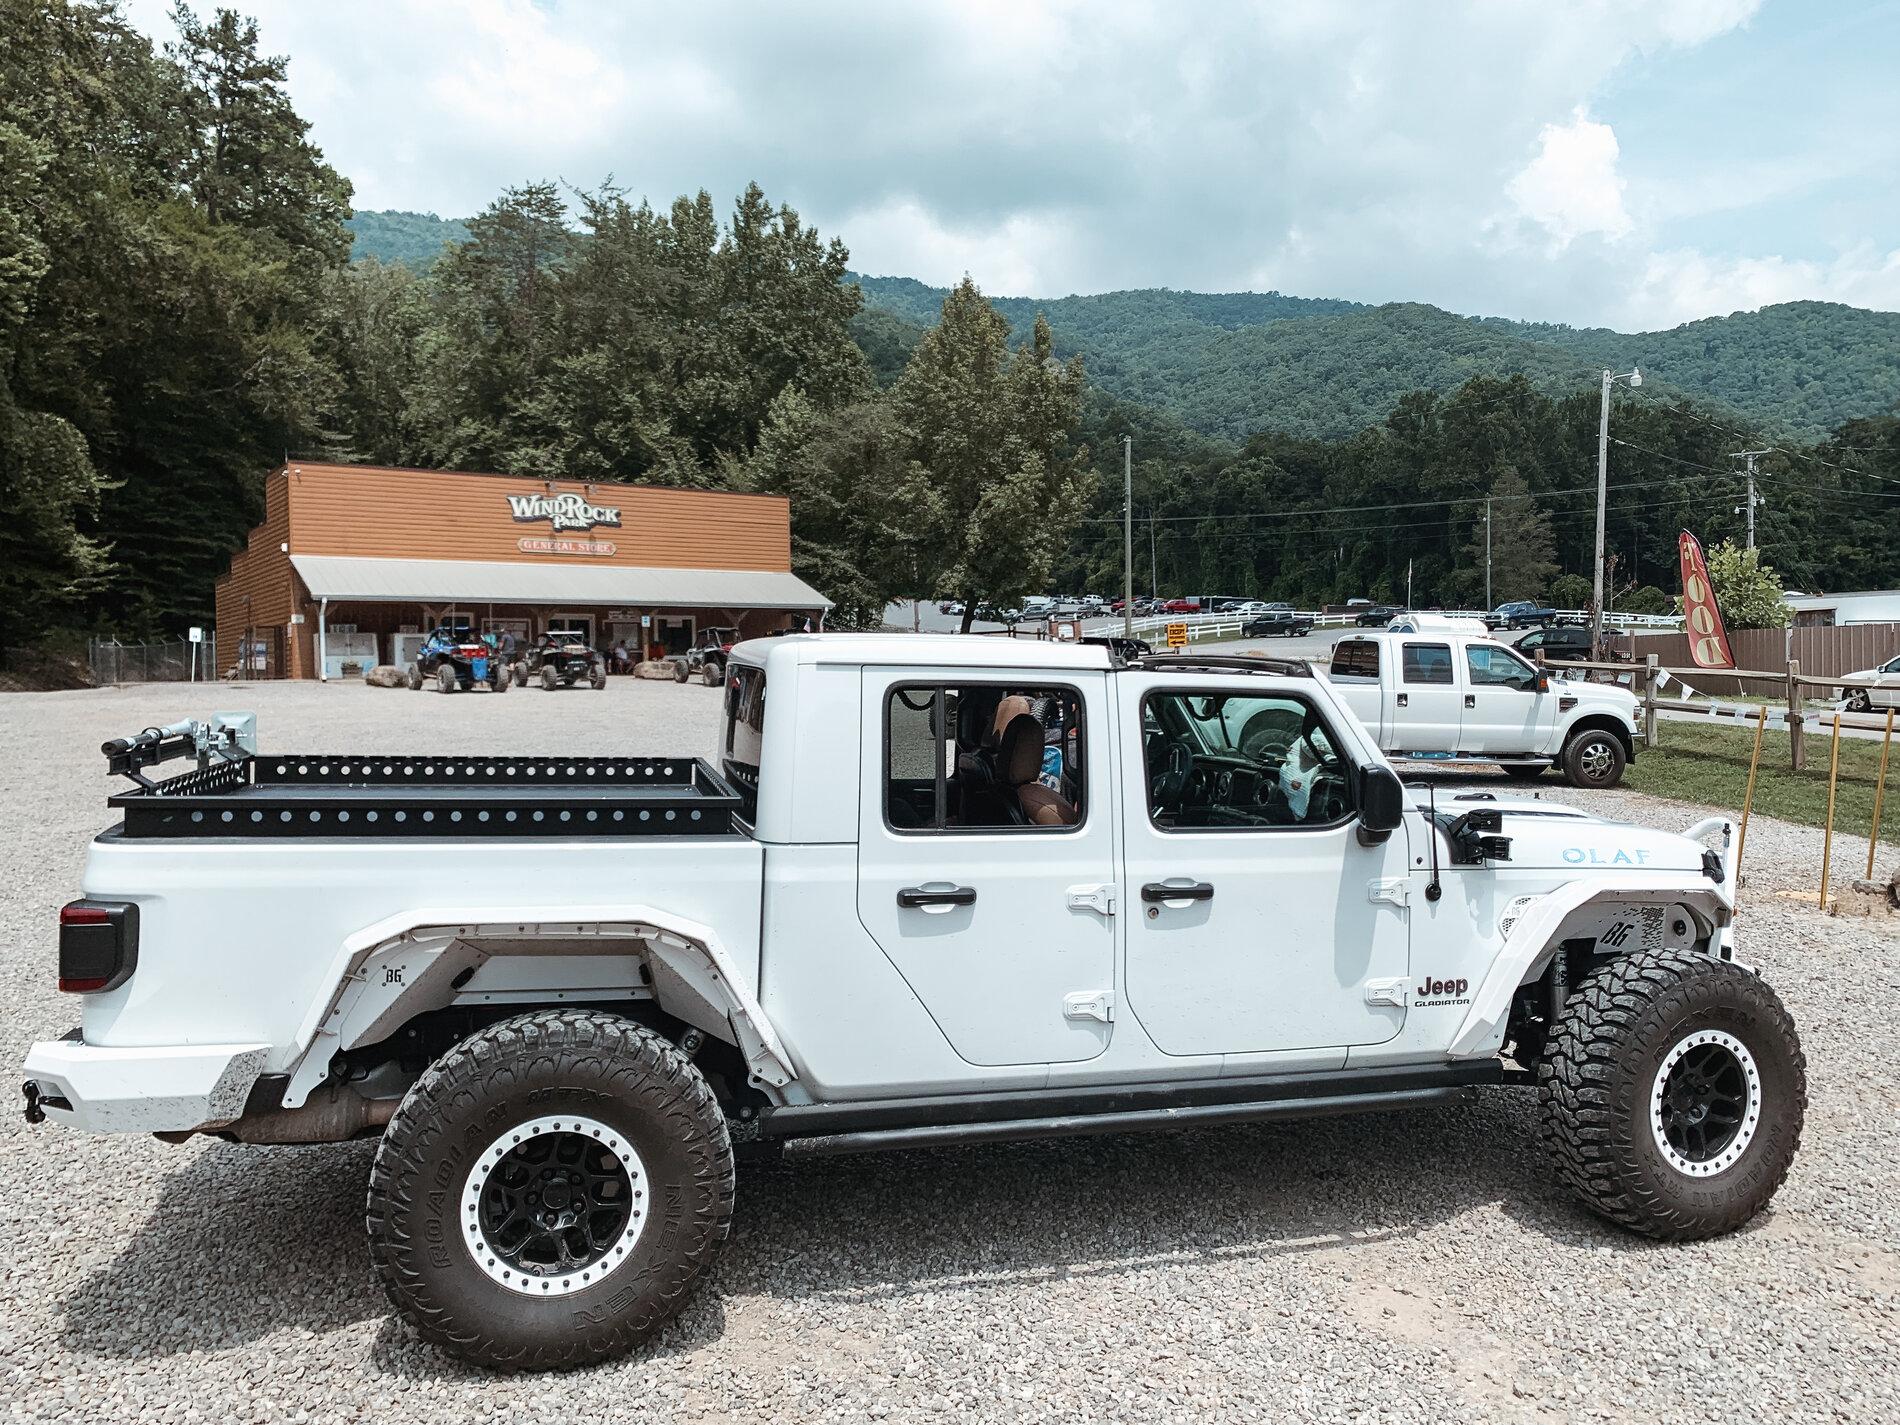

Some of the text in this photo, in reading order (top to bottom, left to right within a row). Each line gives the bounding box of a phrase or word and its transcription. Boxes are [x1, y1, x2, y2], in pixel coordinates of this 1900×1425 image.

[549, 513, 588, 529] PARK
[523, 540, 610, 552] GENERAL STORE
[1562, 848, 1651, 865] OLAF
[1417, 976, 1468, 997] Jeep
[1414, 999, 1470, 1007] GLADIATOR
[574, 1183, 682, 1331] NEXEN
